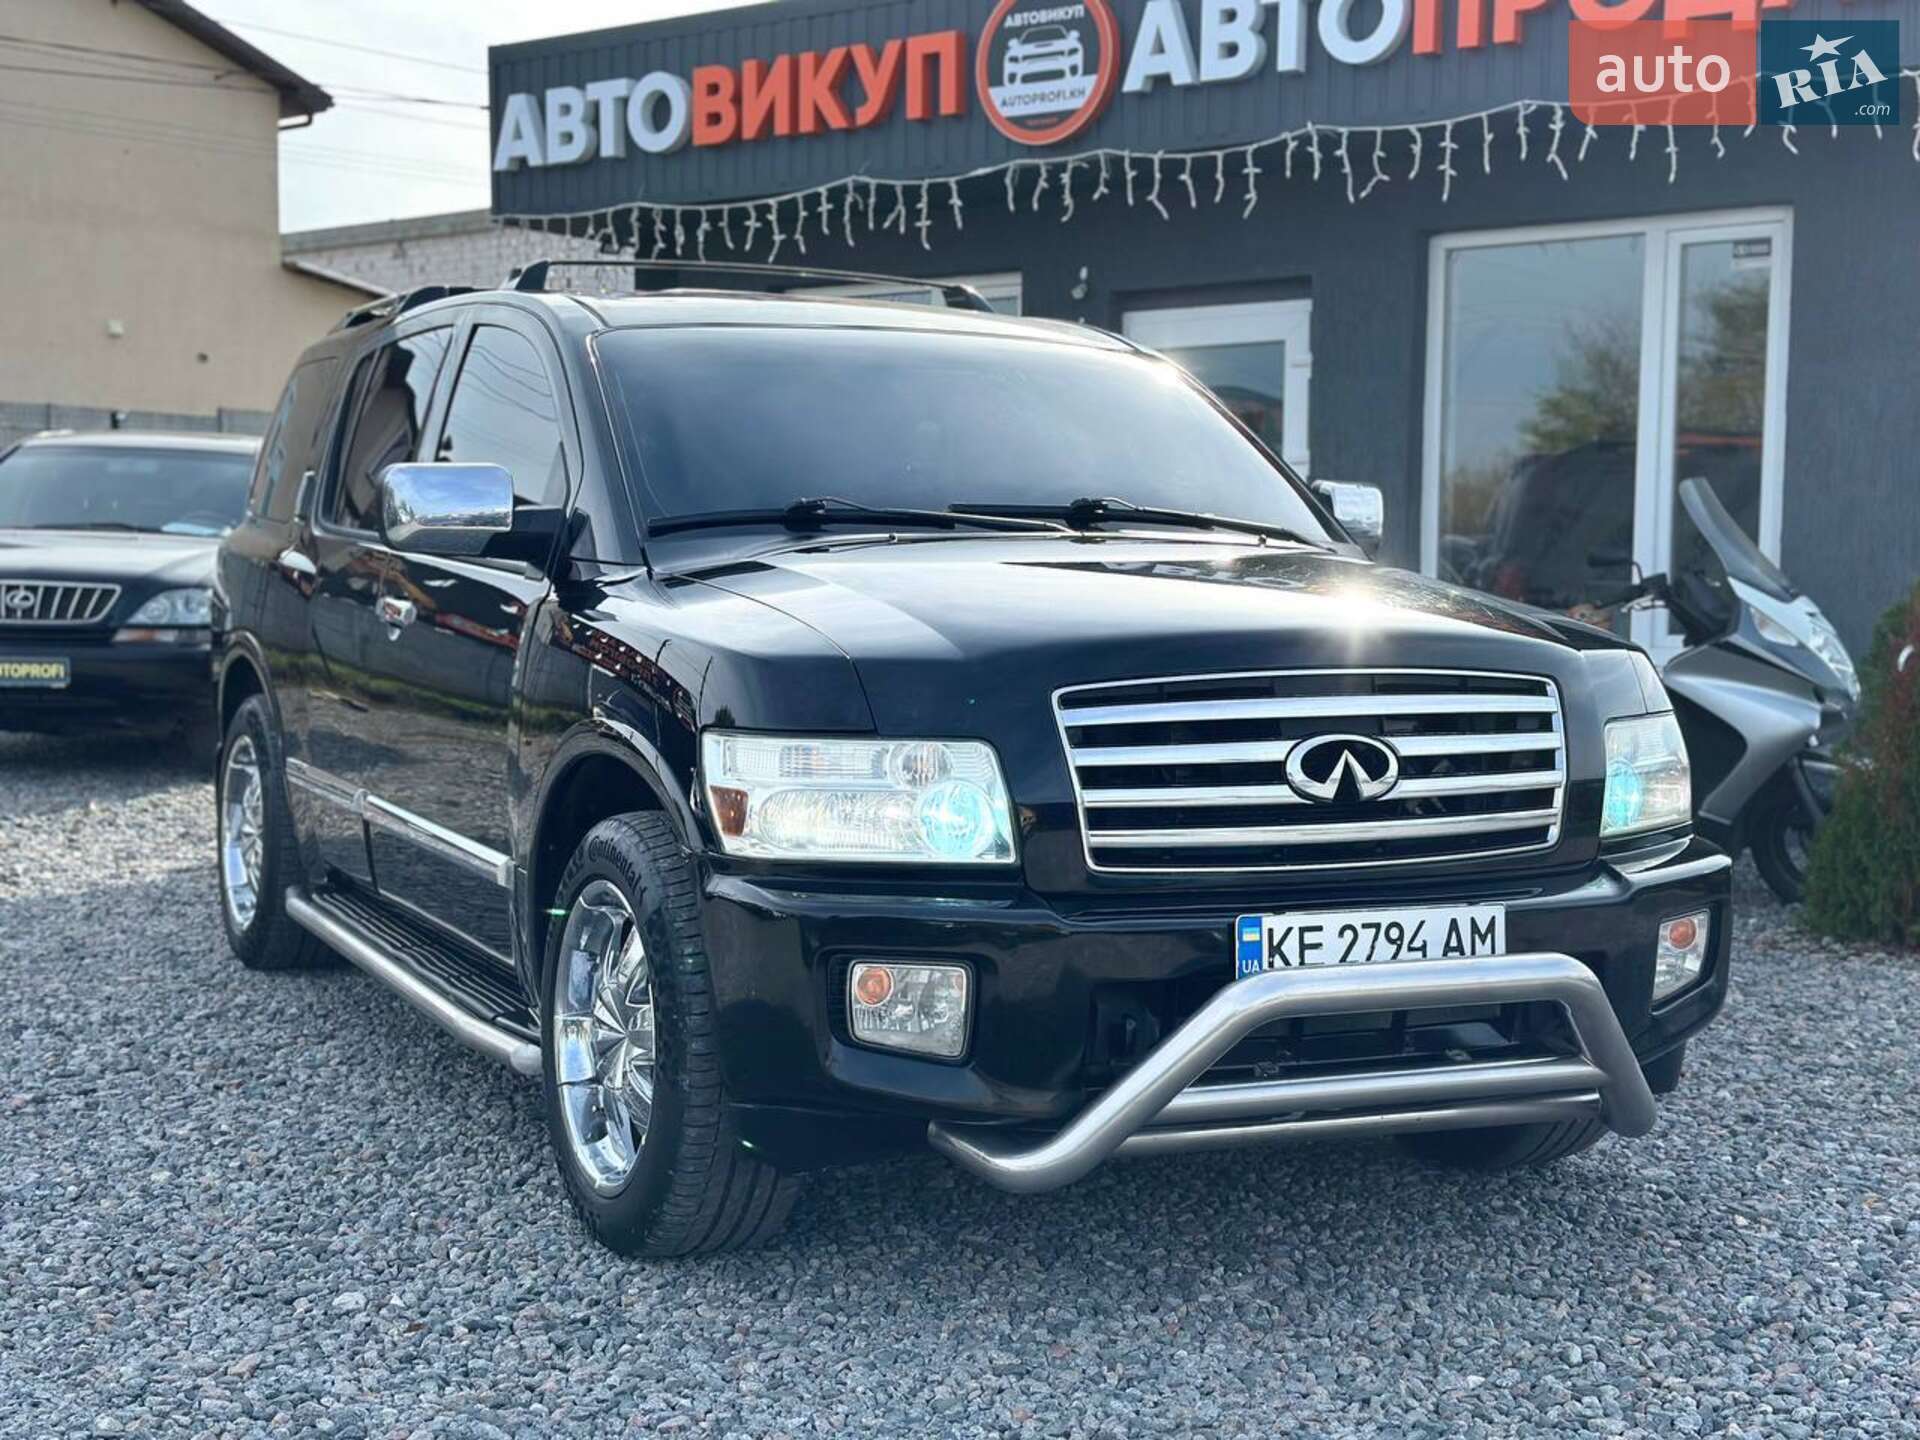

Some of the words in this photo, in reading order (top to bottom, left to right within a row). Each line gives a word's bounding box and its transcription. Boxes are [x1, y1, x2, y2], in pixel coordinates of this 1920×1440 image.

[1004, 5, 1084, 27] АВТОВИКУП
[494, 30, 965, 171] АВТОВИКУП
[1267, 925, 1324, 968] KE
[1337, 920, 1427, 963] 2794
[1442, 915, 1496, 956] AM
[1242, 959, 1261, 973] UA
